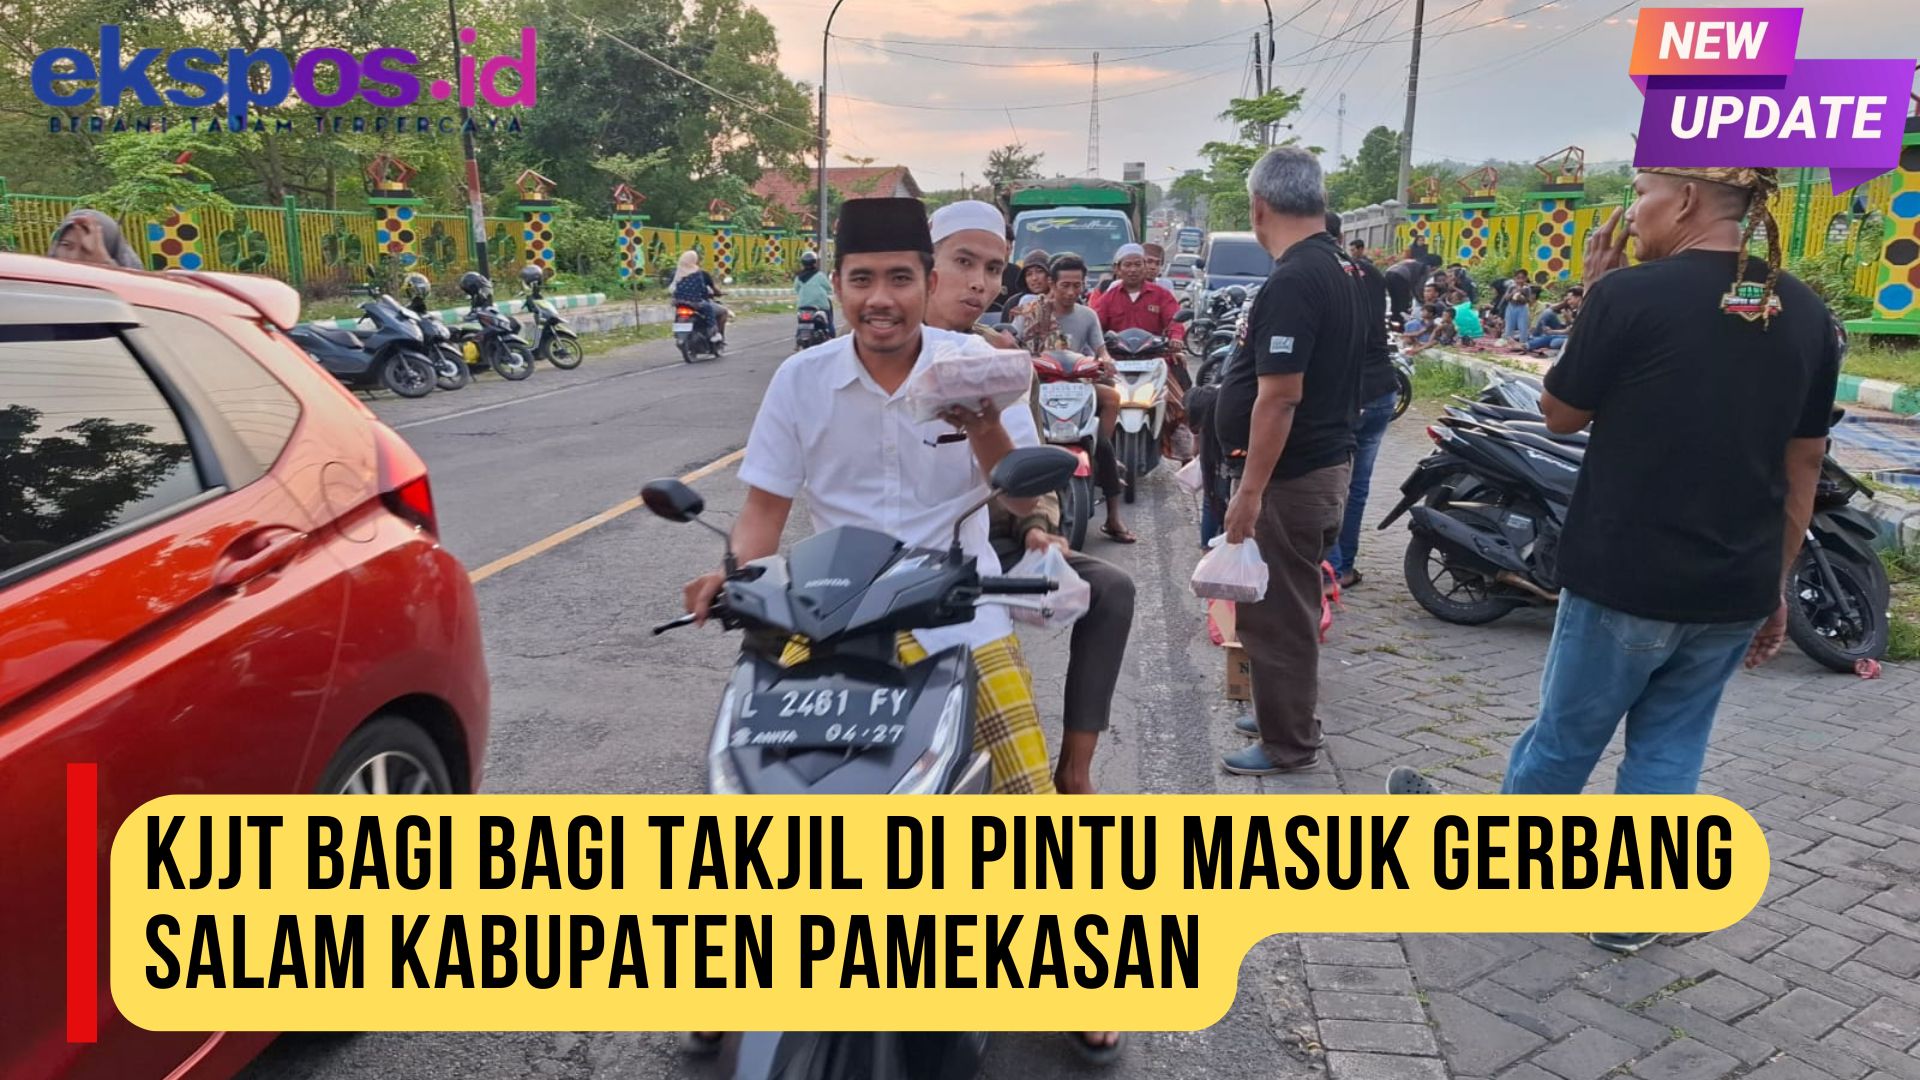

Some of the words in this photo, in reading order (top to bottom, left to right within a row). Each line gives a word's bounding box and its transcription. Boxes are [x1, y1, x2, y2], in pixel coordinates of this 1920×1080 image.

[741, 692, 757, 718] L
[779, 689, 849, 718] 2461
[869, 688, 907, 717] FY
